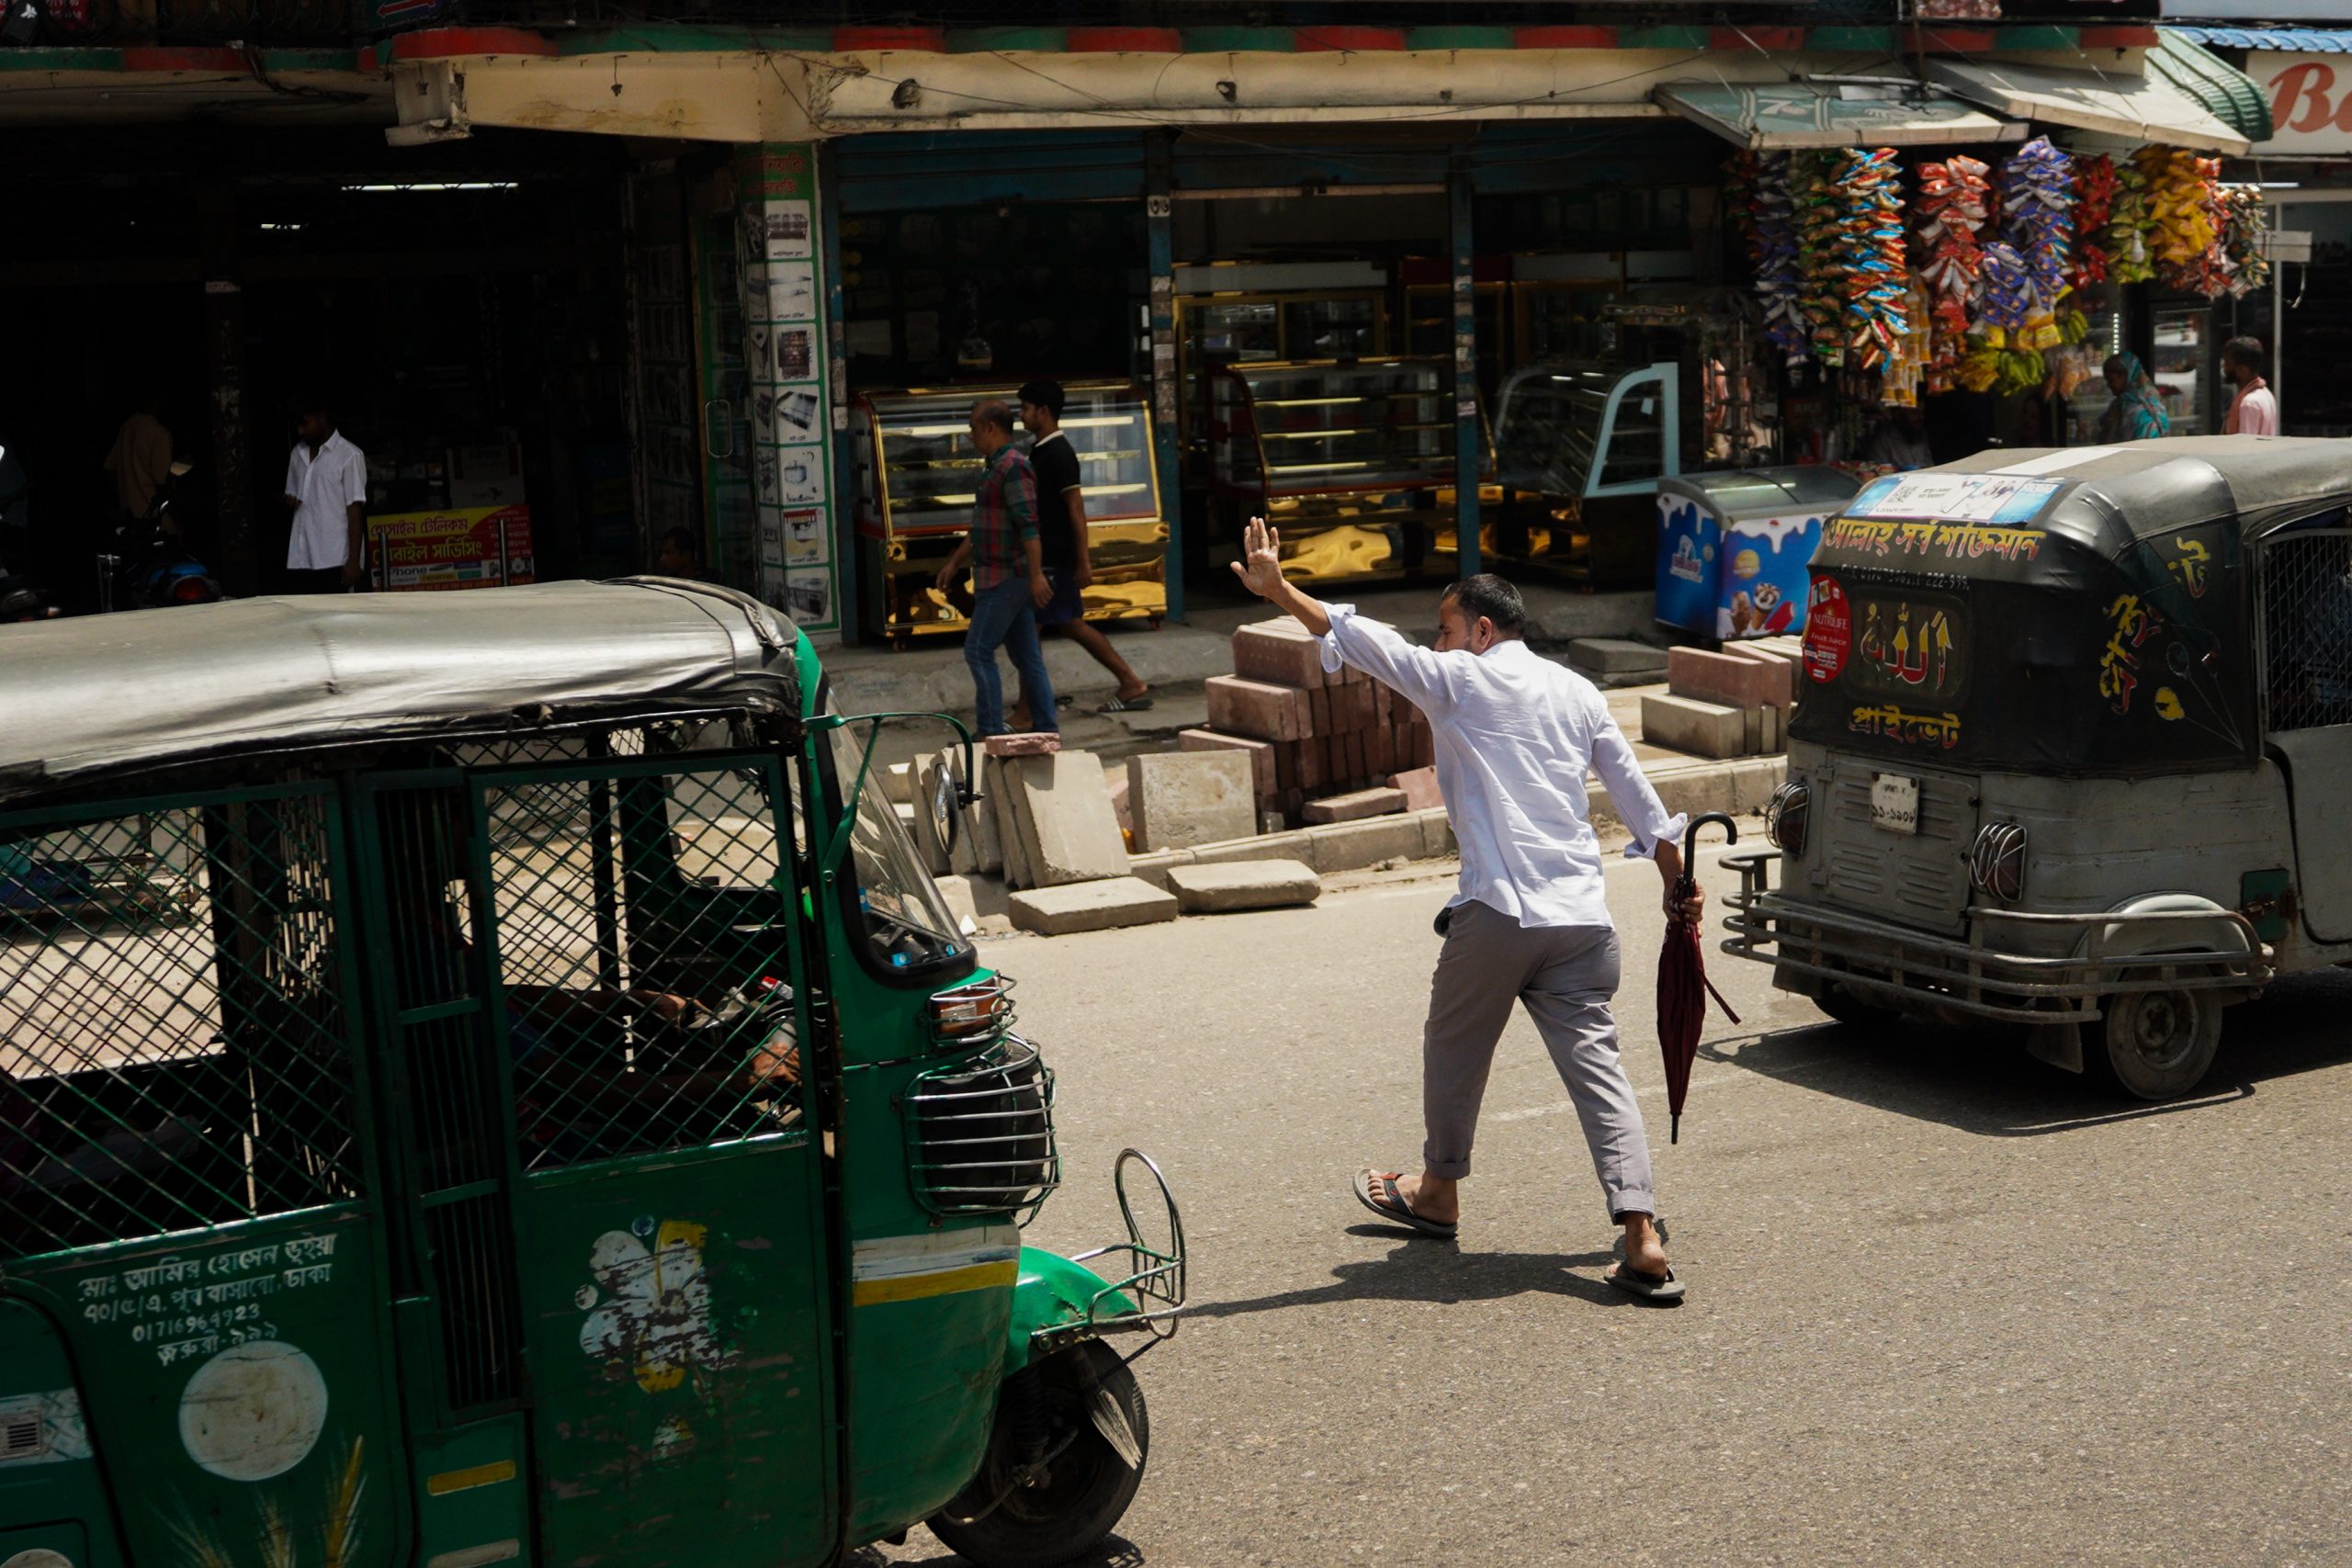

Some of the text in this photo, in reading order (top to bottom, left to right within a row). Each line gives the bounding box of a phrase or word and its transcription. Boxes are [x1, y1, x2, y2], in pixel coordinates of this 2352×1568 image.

[421, 514, 468, 533] টেলিকম
[372, 536, 484, 565] োবাইল সার্ভিসিং
[1813, 613, 1849, 630] NUTRILIFE
[1811, 631, 1848, 647] Fruit Juice
[1848, 705, 1962, 750] প্রাইভেট
[122, 1255, 201, 1291] আমির
[208, 1244, 279, 1275] হোসেন
